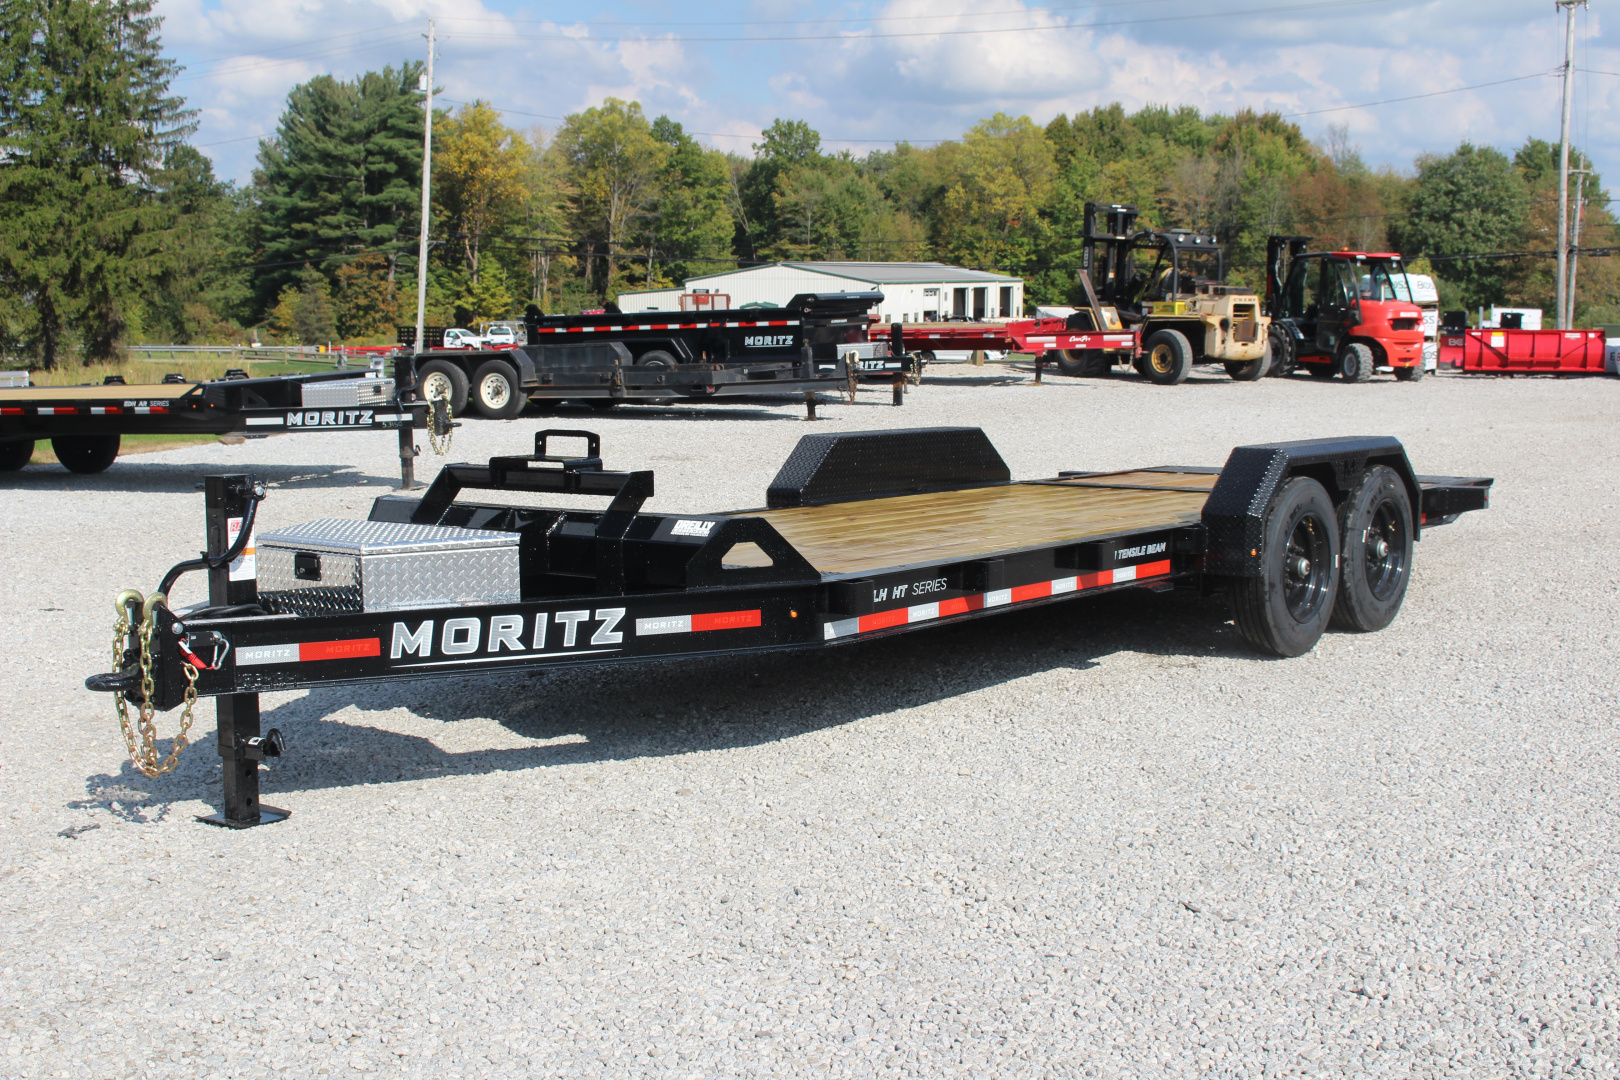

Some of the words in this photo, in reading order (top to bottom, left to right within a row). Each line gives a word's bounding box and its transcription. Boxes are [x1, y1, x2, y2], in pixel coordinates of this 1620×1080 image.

[744, 335, 794, 346] MORITZ
[855, 360, 885, 369] RITZ
[286, 410, 374, 426] MORITZ
[1118, 545, 1147, 560] TENSILE
[1146, 541, 1167, 555] BEAM
[1116, 570, 1134, 579] MORITZ
[892, 584, 909, 599] HT
[911, 578, 948, 596] SERIES
[1055, 581, 1074, 590] MORITZ
[987, 593, 1008, 603] MORITZ
[912, 607, 936, 617] MORITZ
[644, 619, 684, 631] MORITZ
[713, 614, 753, 626] MORITZ
[390, 607, 626, 659] MORITZ
[325, 643, 371, 654] MORITZ
[245, 649, 291, 660] MORITZ
